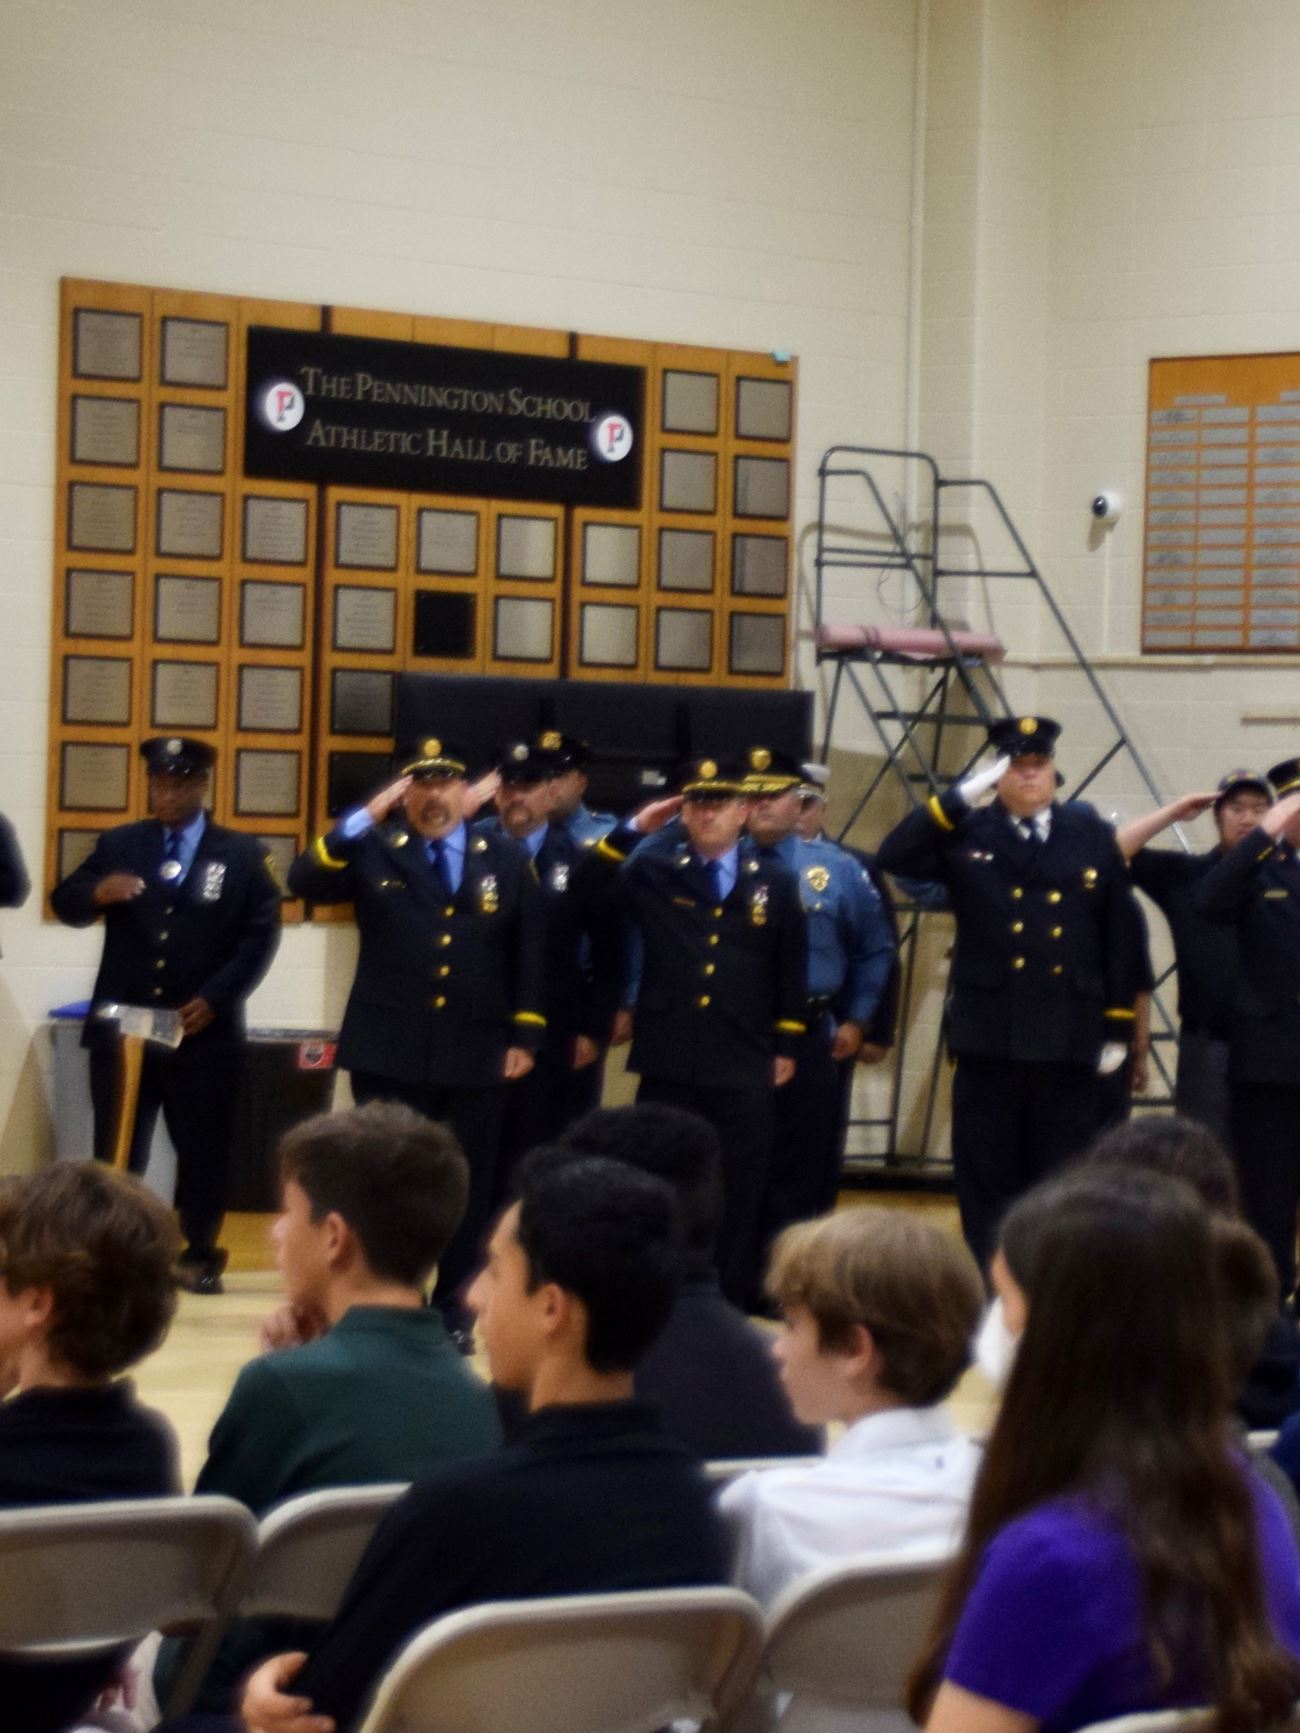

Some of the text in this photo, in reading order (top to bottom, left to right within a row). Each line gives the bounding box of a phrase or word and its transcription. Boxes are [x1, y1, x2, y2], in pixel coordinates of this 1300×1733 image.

[300, 367, 598, 423] THE PENNINGTON SCHOOL
[305, 418, 589, 471] ATHLETIC HALL OF FAME
